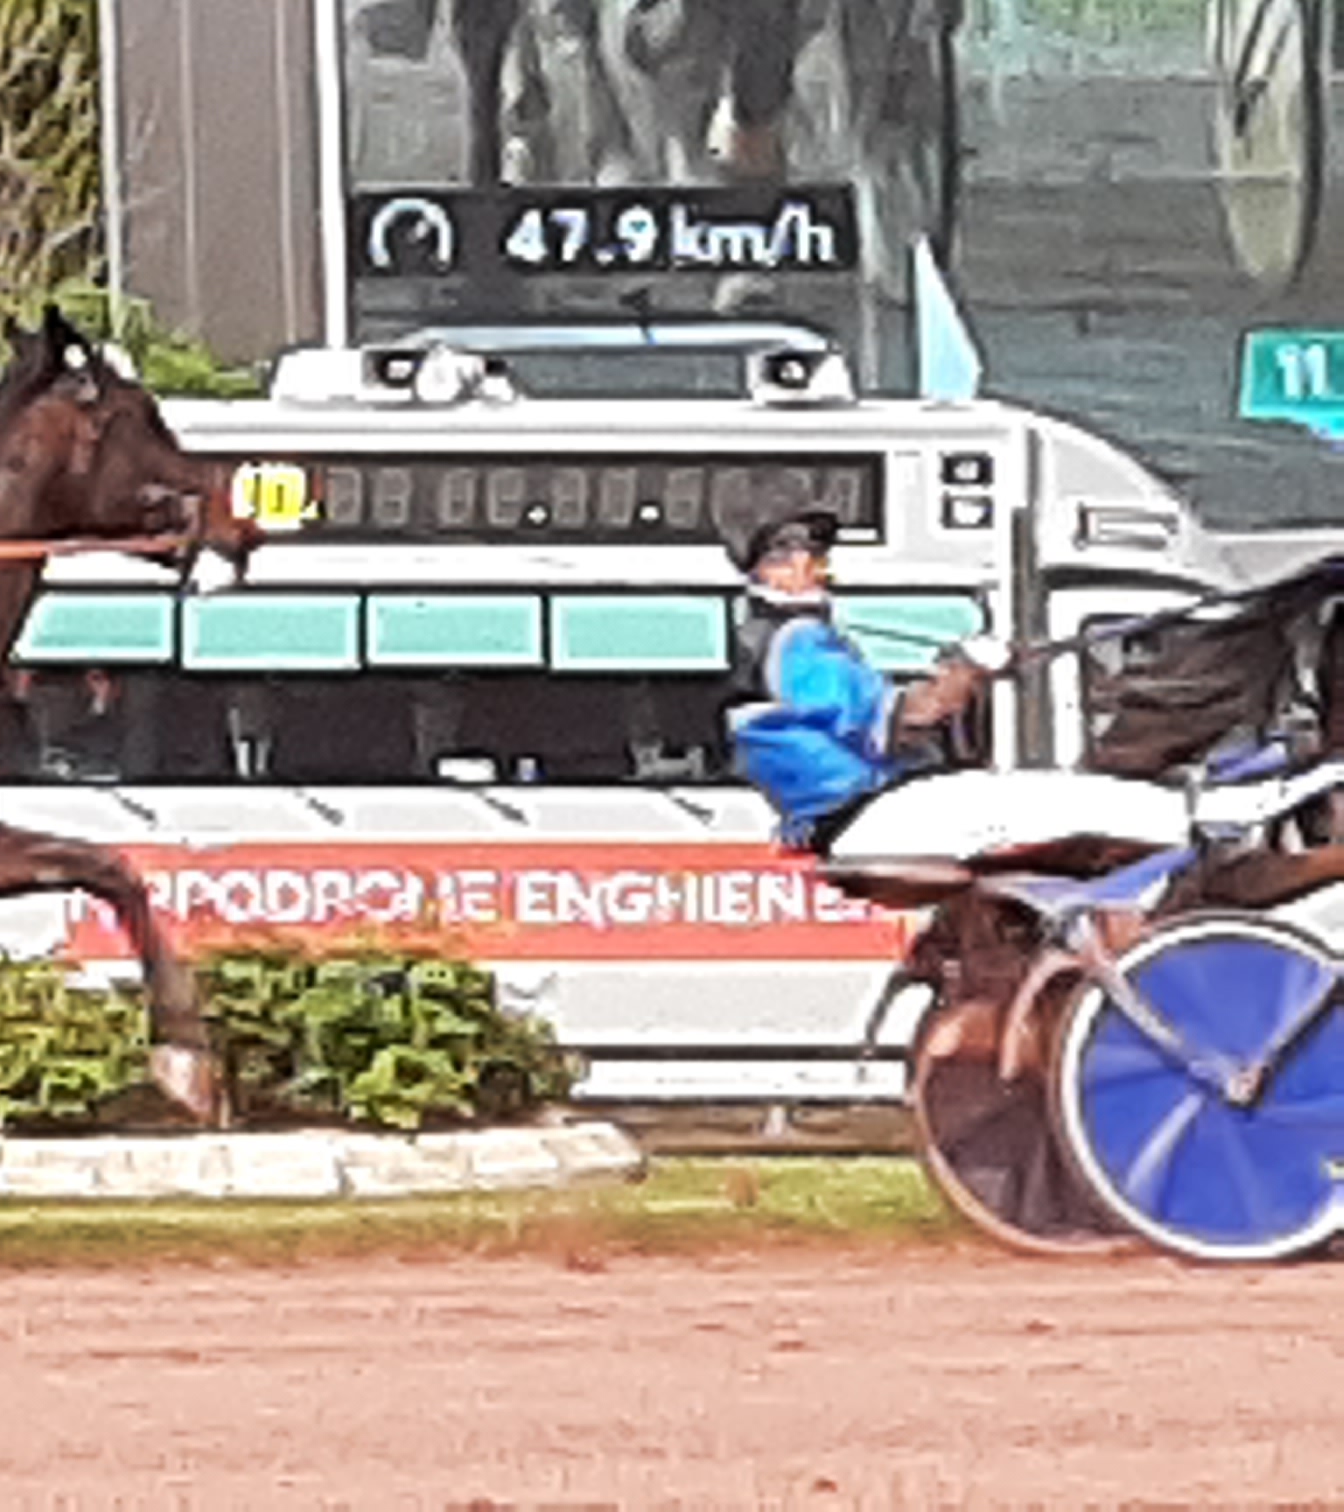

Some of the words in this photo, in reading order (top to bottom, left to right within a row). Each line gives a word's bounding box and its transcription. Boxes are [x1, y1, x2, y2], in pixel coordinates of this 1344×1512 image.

[505, 205, 658, 263] 47.9
[670, 202, 834, 266] km/h
[69, 868, 498, 925] HPPODROME
